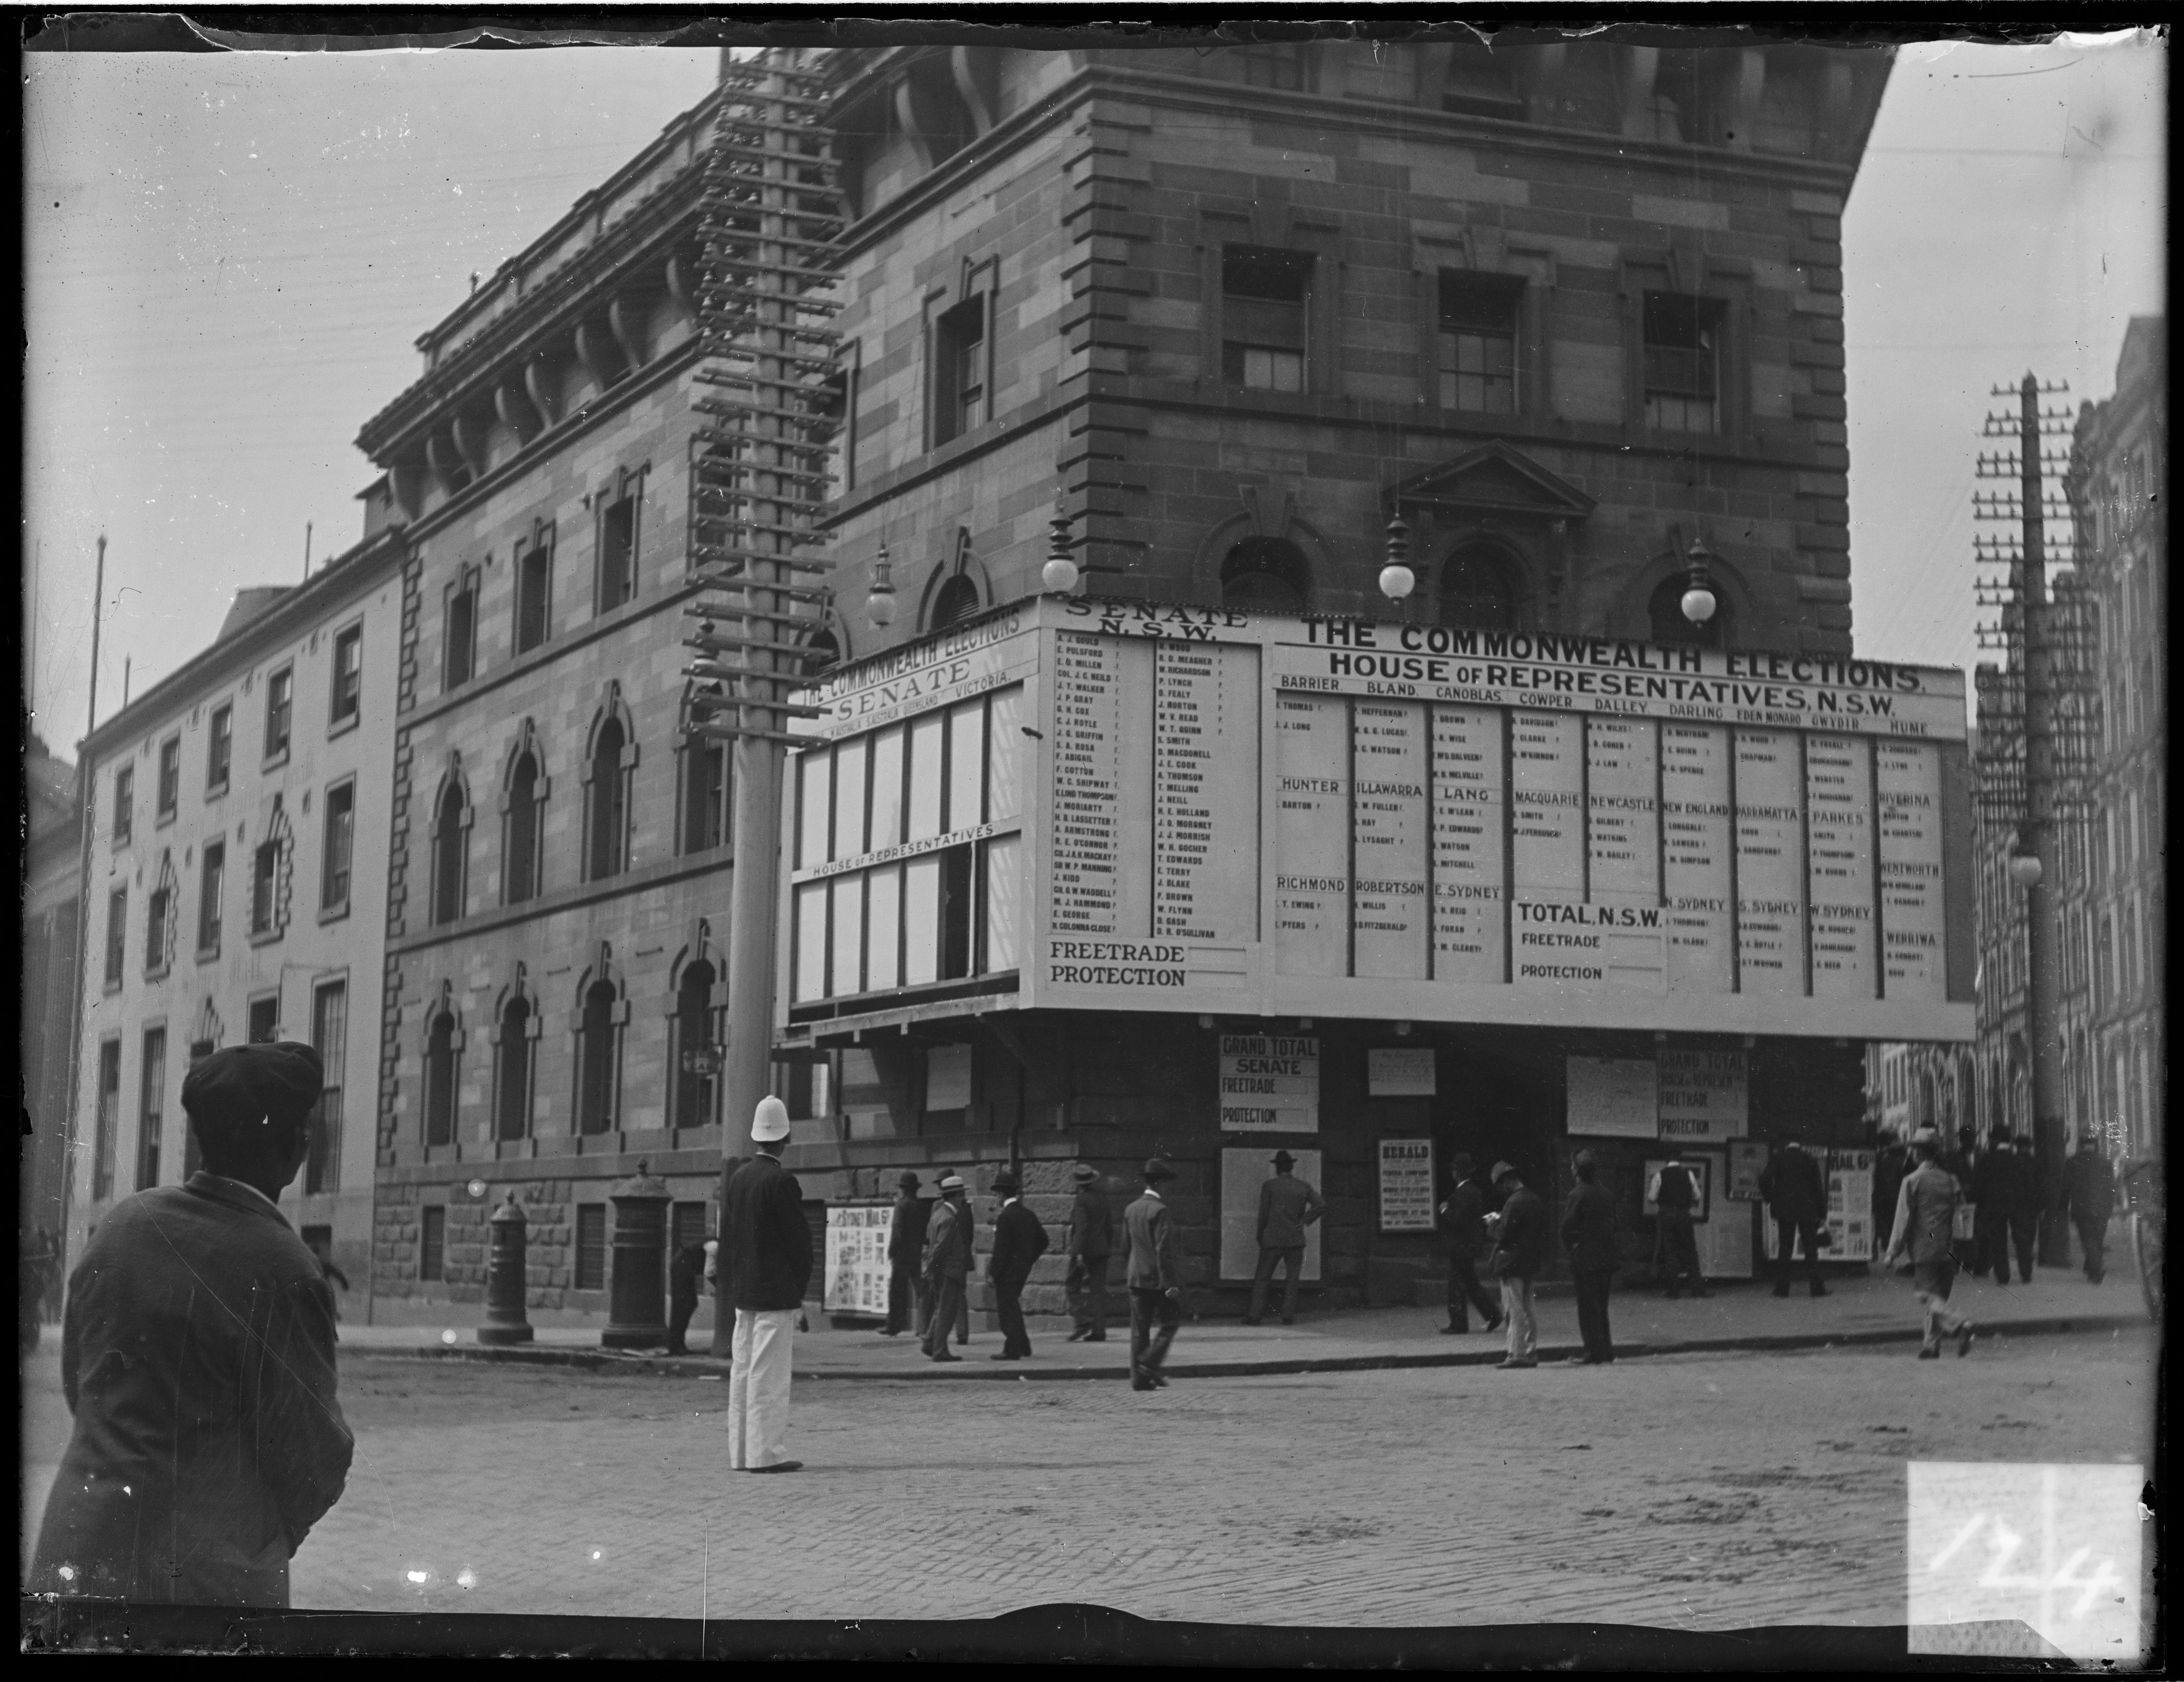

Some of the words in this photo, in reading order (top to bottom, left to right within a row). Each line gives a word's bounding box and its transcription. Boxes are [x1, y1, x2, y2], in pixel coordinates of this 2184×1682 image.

[1065, 598, 1248, 628] SENATE
[1098, 618, 1216, 641] N.S.W.
[1066, 646, 1103, 658] PULSFORD
[1301, 618, 1376, 647] THE
[1400, 626, 1702, 673] COMMONWEALTH
[1727, 653, 1926, 693] ELECTIONS.
[1075, 659, 1102, 669] MILLEN
[1178, 655, 1212, 666] MEAGHER
[1076, 683, 1104, 693] WALKER
[1168, 678, 1192, 687] LYNCH
[1330, 653, 1450, 682] HOUSE
[1457, 666, 1482, 683] OF
[1487, 664, 1811, 712] REPRESENTATIVES,
[1818, 691, 1896, 717] N.S.W.
[838, 658, 970, 721] SENATE
[1168, 689, 1191, 699] FEALY
[1074, 718, 1097, 728] ROYLE
[1075, 731, 1103, 741] GRIFFIN
[1166, 736, 1191, 746] SMITH
[1065, 753, 1093, 762] ABIGAIL
[1065, 766, 1094, 775] COTTON
[1176, 761, 1196, 769] COOK
[1167, 772, 1204, 782] THOMSON
[1076, 778, 1109, 789] SHIPWAY
[1166, 784, 1199, 794] MELLING
[1283, 779, 1339, 793] HUNTER
[1357, 783, 1423, 797] ILLAWARRA
[1444, 787, 1488, 801] LANG
[1166, 795, 1188, 805] NEILL
[1515, 791, 1579, 807] MACQUARIE
[1591, 795, 1654, 811] NEWCASTLE
[1879, 792, 1930, 807] RIVERINA
[1064, 802, 1103, 812] MORIARTY
[1282, 800, 1312, 810] BARTON
[1176, 807, 1210, 817] HOLLAND
[1071, 814, 1111, 825] LASSETTER
[1813, 811, 1863, 825] PARKES
[1065, 825, 1109, 838] ARMSTRONG
[1176, 831, 1211, 841] MORRISH
[1073, 839, 1108, 849] O'CONNOR
[813, 859, 851, 877] HOUSE
[869, 825, 993, 863] REPRESENTATIVES
[1166, 855, 1203, 865] EDWARDS
[1166, 867, 1191, 877] TERRY
[1881, 862, 1939, 878] WENTWORTH
[1062, 874, 1080, 883] KIDD
[1166, 878, 1191, 888] BLAKE
[1277, 877, 1345, 892] RICHMOND
[1356, 880, 1424, 895] ROBERTSON
[1166, 892, 1193, 902] BROWN
[1073, 899, 1111, 910] HAMMOND
[1168, 905, 1193, 915] FLYNN
[1062, 910, 1090, 920] GEORGE
[1599, 907, 1662, 928] N.S.W.
[1166, 917, 1186, 926] GASH
[1522, 933, 1600, 948] FREETRADE
[1050, 941, 1185, 963] FREETRADE
[1051, 965, 1186, 987] PROTECTION
[1521, 965, 1602, 980] PROTECTION
[1223, 1036, 1266, 1056] GRAND
[1272, 1038, 1316, 1057] TOTAL
[1236, 1059, 1301, 1076] SENATE
[1222, 1077, 1276, 1094] FREETRADE
[1222, 1107, 1277, 1124] PROTECTION
[1660, 1118, 1710, 1135] PROTECTION
[1382, 1145, 1429, 1159] HERALD
